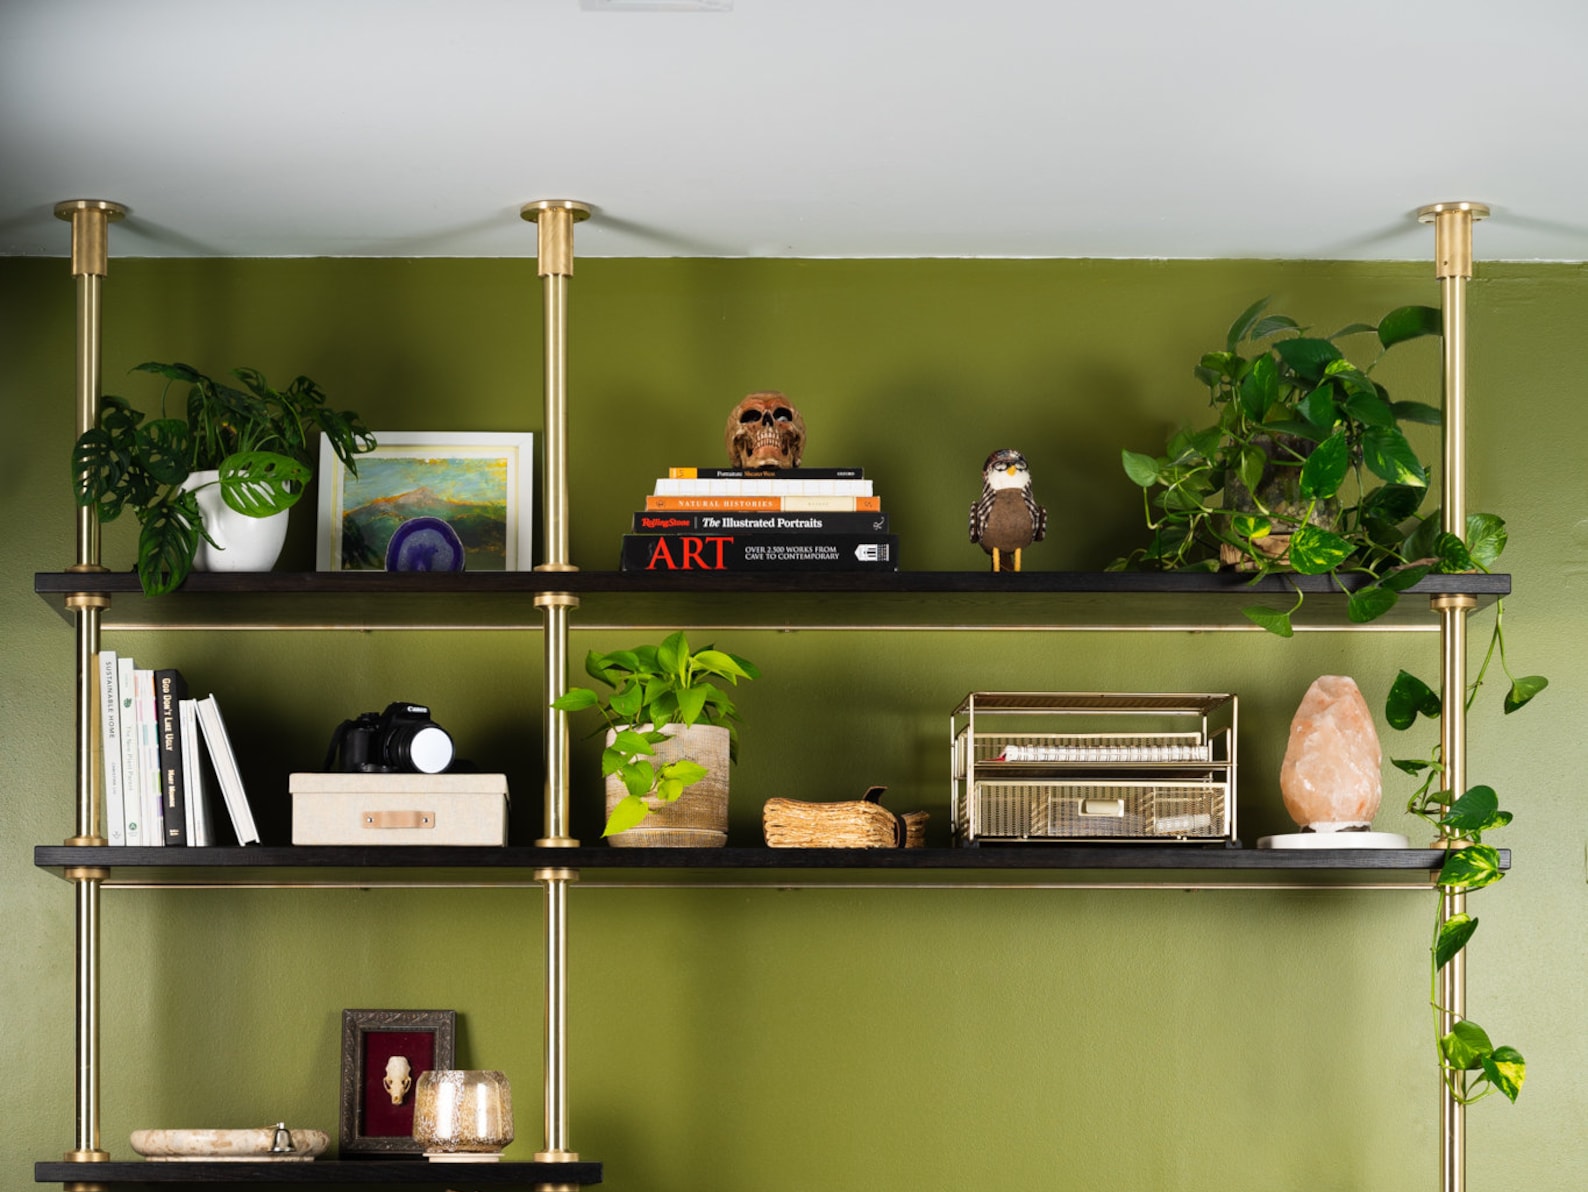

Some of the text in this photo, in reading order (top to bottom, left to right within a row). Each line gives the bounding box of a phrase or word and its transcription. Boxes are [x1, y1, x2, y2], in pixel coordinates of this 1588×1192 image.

[678, 499, 774, 508] NATURAL HISTORIES
[702, 517, 823, 528] The Illustrated Portraits
[644, 535, 735, 570] ART
[105, 661, 116, 739] SUSTAINABLE HOME
